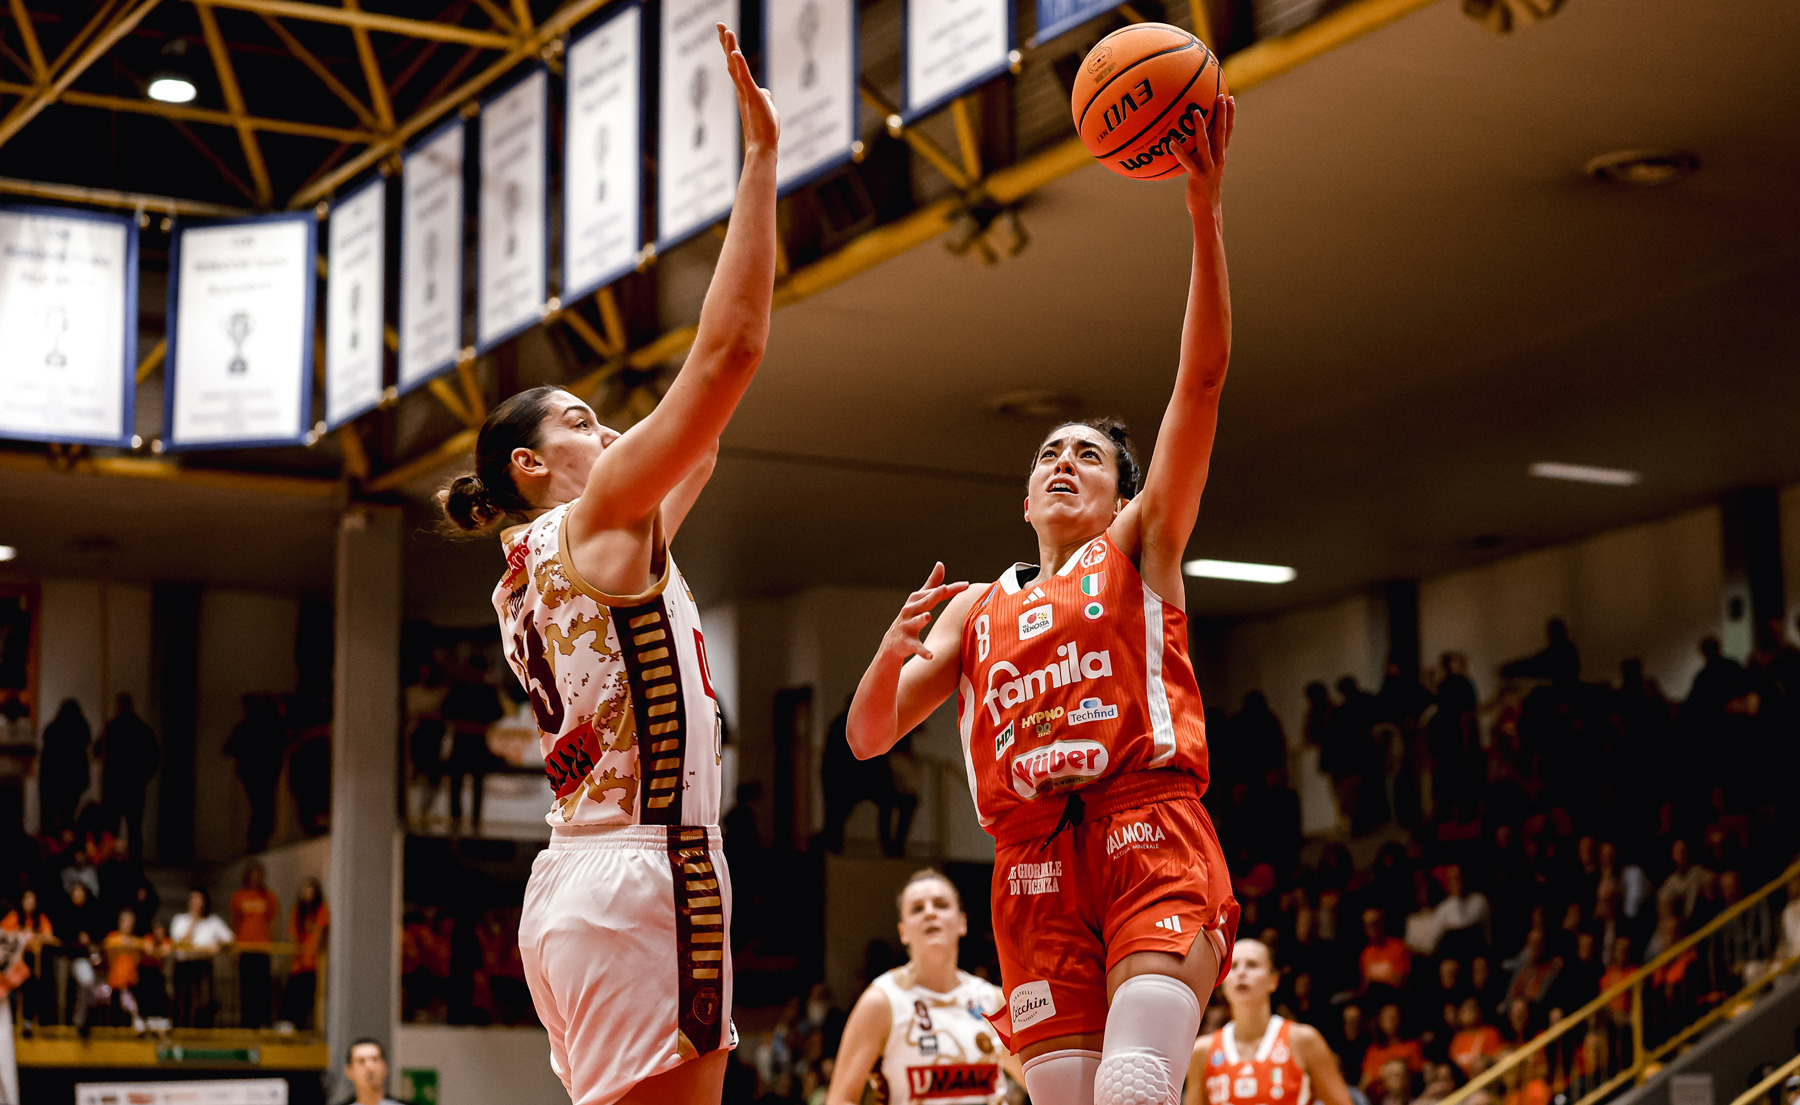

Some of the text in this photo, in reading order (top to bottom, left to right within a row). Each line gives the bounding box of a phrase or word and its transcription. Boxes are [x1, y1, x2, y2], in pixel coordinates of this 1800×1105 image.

[1103, 78, 1154, 132] EVO
[1096, 129, 1109, 144] NXT
[1118, 102, 1209, 171] Wilson
[974, 614, 991, 663] 8
[1022, 620, 1050, 634] VENOSTA
[982, 640, 1113, 727] famila
[1021, 705, 1065, 729] HYPNO
[1070, 707, 1115, 723] Techfind
[996, 723, 1013, 752] HDI
[1012, 747, 1101, 790] Wüber
[1009, 879, 1021, 896] DI
[914, 1000, 933, 1031] 9
